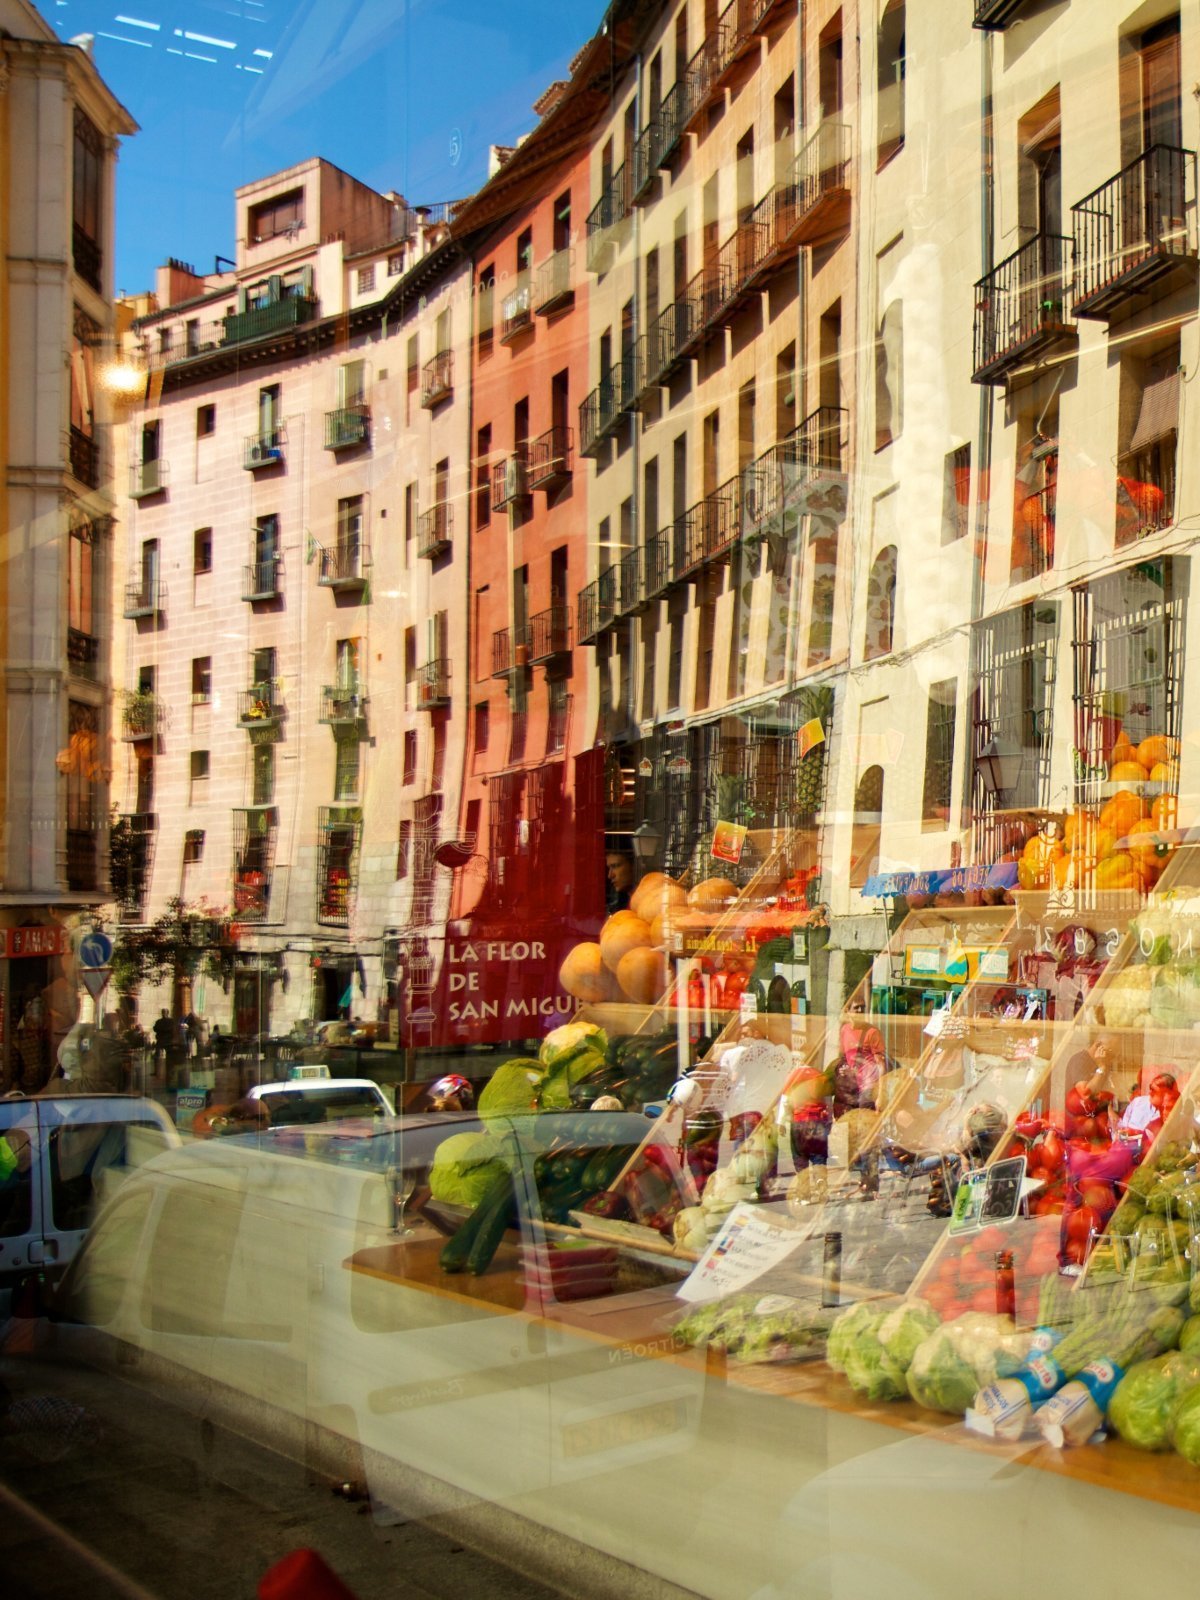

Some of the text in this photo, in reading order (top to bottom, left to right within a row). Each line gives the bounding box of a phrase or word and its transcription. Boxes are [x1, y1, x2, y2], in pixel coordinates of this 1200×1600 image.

[449, 941, 547, 963] LA FLOR
[449, 971, 480, 992] DE
[448, 999, 499, 1021] SAN
[178, 1096, 204, 1107] alpro
